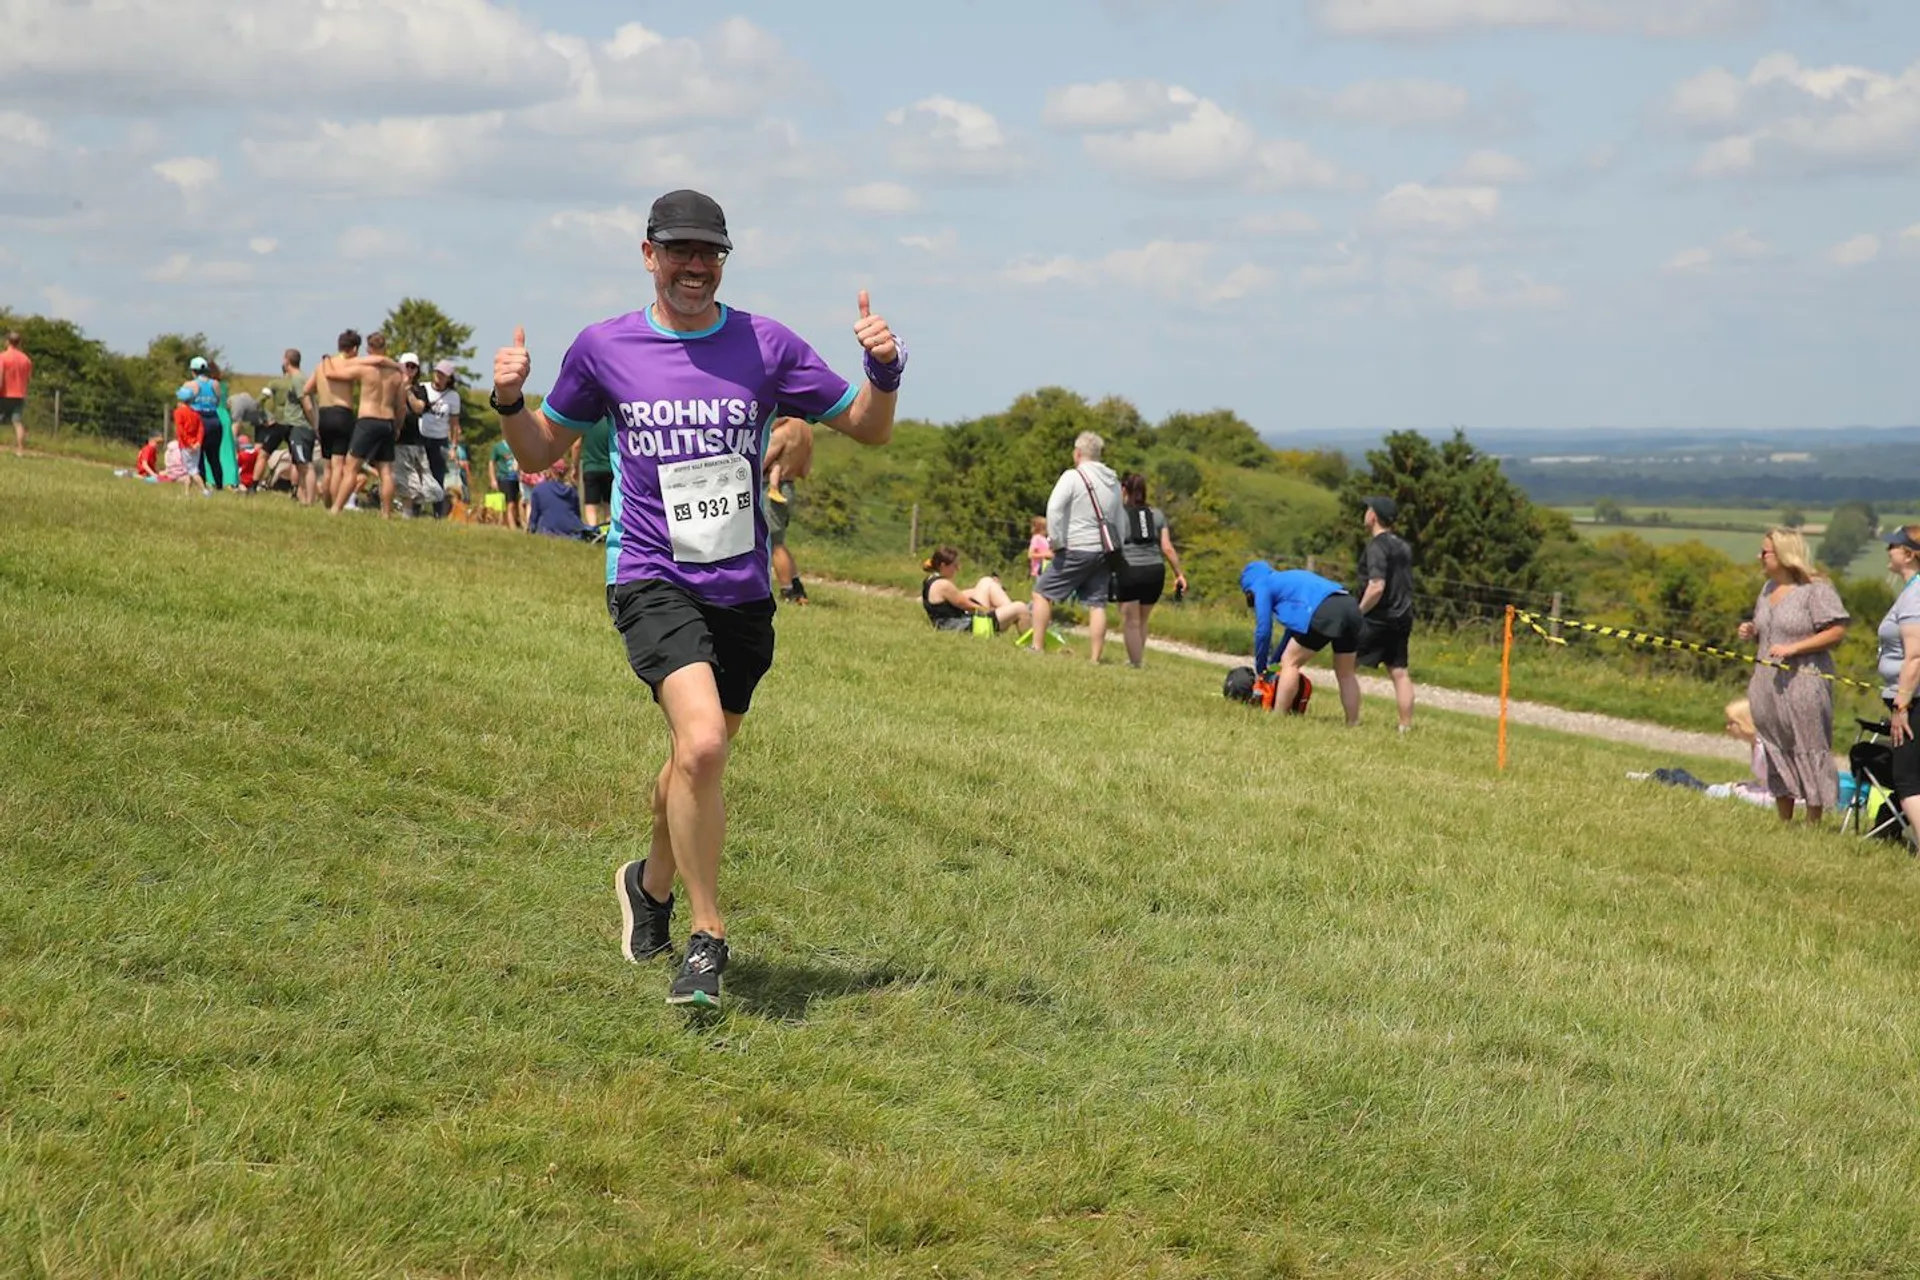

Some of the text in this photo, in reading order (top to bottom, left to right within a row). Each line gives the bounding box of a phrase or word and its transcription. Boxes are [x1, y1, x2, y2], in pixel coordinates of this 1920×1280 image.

[619, 399, 758, 427] CROHN'S &
[628, 428, 757, 457] COLITIS UK
[698, 497, 730, 520] 932
